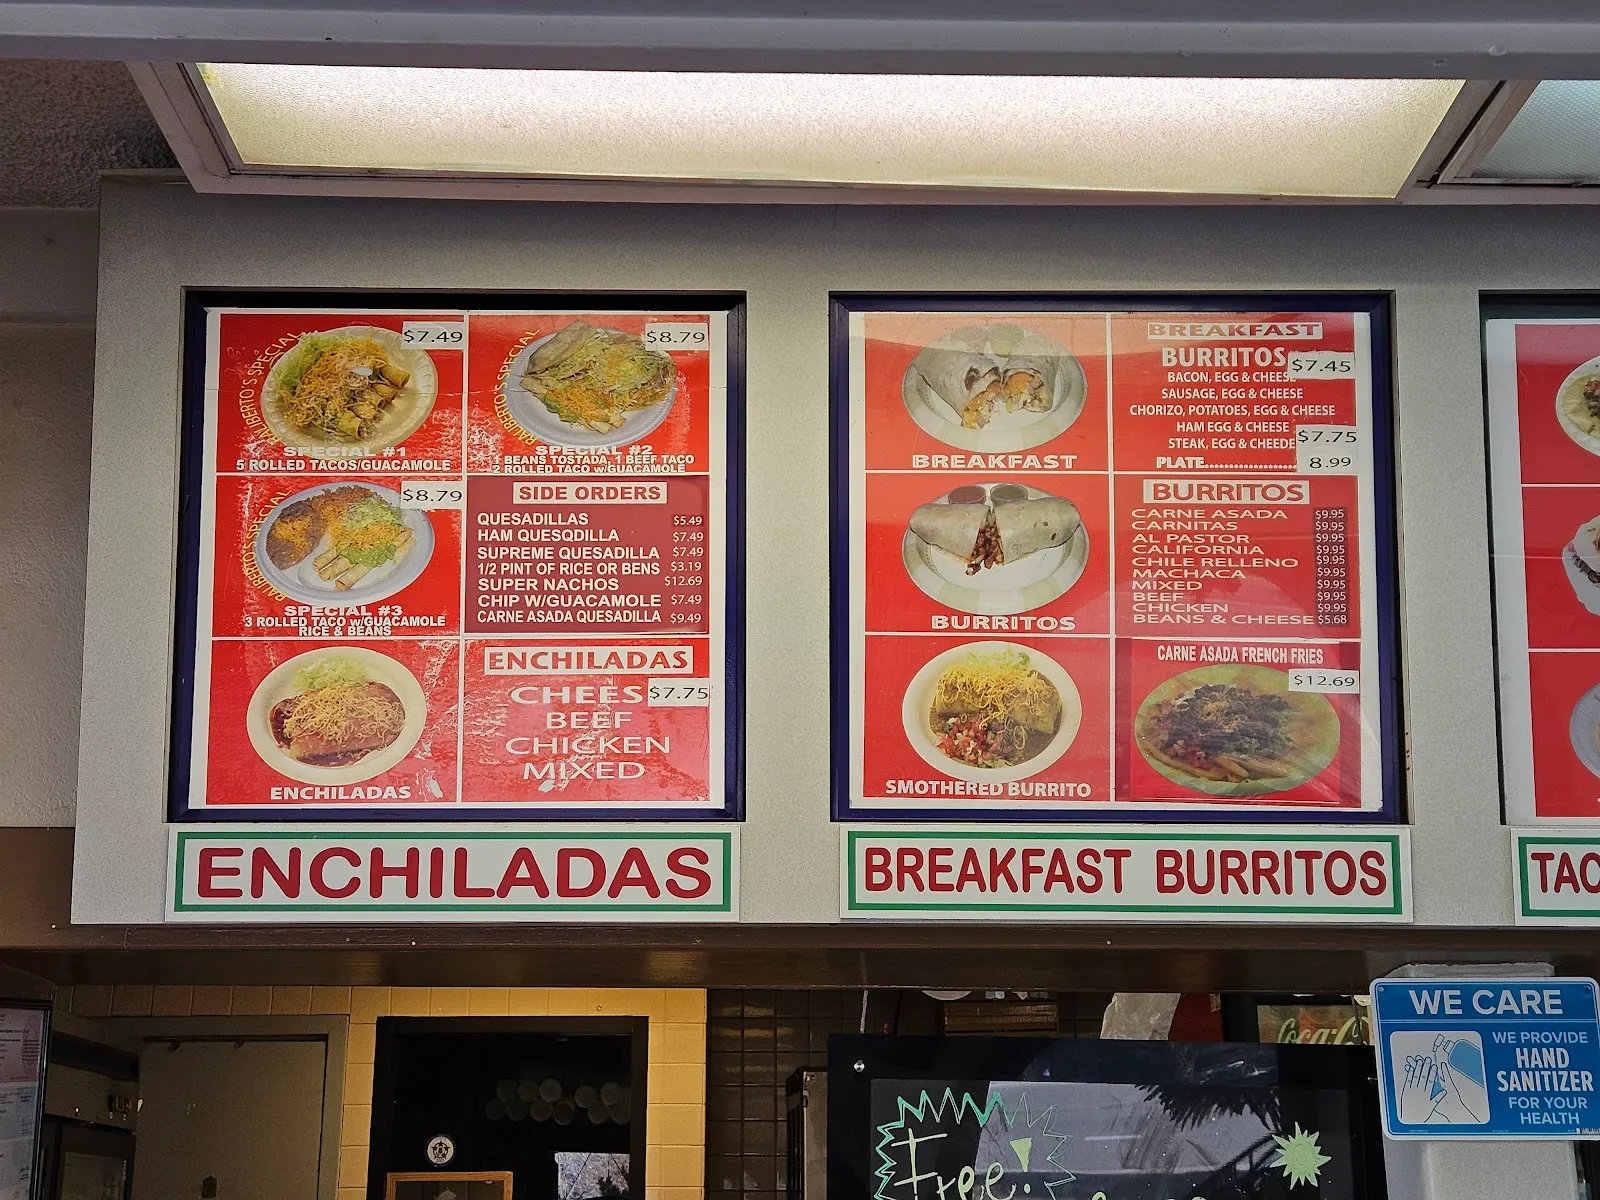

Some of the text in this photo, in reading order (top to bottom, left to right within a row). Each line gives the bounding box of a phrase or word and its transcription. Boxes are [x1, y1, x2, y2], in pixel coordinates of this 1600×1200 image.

[403, 329, 463, 343] $7.49
[1149, 324, 1320, 337] BREAKFAST
[647, 331, 705, 344] $8.79
[246, 331, 303, 377] SPECIAL
[497, 329, 540, 379] SPECIAL
[1162, 347, 1286, 367] BURRITOS
[1292, 359, 1351, 372] $7.45
[1167, 371, 1212, 384] BACON,
[1215, 372, 1239, 383] EGG
[1242, 372, 1250, 382] &
[1161, 388, 1303, 400] SAUSAGE, EGG & CHEESE
[1130, 405, 1335, 417] CHORIZO, POTATOES, EGG & CHEESE
[1177, 422, 1289, 433] HAM EGG & CHEESE
[1298, 429, 1357, 443] $7.75
[535, 445, 653, 455] SPECIAL #2
[1168, 438, 1208, 450] STEAK,
[1212, 438, 1236, 449] EGG
[1238, 438, 1247, 449] &
[283, 446, 406, 457] SPECIAL #1
[236, 459, 450, 471] 5 ROLLED TACOS/GUACAMOLE
[493, 455, 695, 465] 1 BEANS TOSTADA, 1 BEEF TACO
[912, 454, 1078, 469] BREAKFAST
[1310, 457, 1351, 469] 8.99
[493, 464, 686, 473] 2 ROLLED TACO w/GUACAMOLE
[403, 488, 462, 502] $8.79
[519, 486, 661, 500] SIDE ORDERS
[1153, 483, 1303, 501] BURRITOS
[246, 490, 292, 540] SPECIAL
[477, 513, 702, 526] QUESADILLAS $5.49
[1131, 509, 1345, 519] CARNE ASADA $9.95
[1132, 521, 1345, 531] CARNITAS $9.95
[478, 530, 704, 543] HAM QUESQDILLA $7.49
[1132, 533, 1345, 544] AL PASTOR $9.95
[477, 547, 704, 560] SUPREME QUESADILLA $7.49
[1132, 545, 1345, 555] CALIFORNIA $9.95
[478, 561, 702, 575] 1/2 PINT OF RICE OR BENS $3.19
[1132, 555, 1345, 568] CHILE RELLENO $9.95
[1132, 567, 1346, 579] MACHACA $9.95
[478, 576, 702, 591] SUPER NACHOS $12.69
[1132, 579, 1346, 590] MIXED $9.95
[478, 595, 702, 607] CHIP W/GUACAMOLE $7.49
[1133, 591, 1346, 602] BEEF $9.95
[284, 606, 403, 617] SPECIAL #3
[1133, 603, 1347, 613] CHICKEN $9.95
[245, 616, 445, 627] 3 ROLLED TACO w/GUACAMOLE
[477, 610, 702, 624] CARNE ASADA QUESADILLA $9.49
[931, 616, 1076, 630] BURRITOS
[1133, 614, 1347, 624] BEANS & CHEESE $5.68
[298, 625, 392, 636] RICE & BEANS
[489, 651, 688, 670] ENCHILADAS
[1157, 645, 1324, 664] CARNE ASADA FRENCH FRIES
[1294, 674, 1355, 687] $12.69
[510, 686, 643, 704] CHEES
[649, 686, 709, 700] $7.75
[546, 712, 633, 729] BEEF
[505, 737, 670, 754] CHICKEN
[523, 762, 646, 780] MIXED
[270, 786, 411, 800] ENCHILADAS
[886, 780, 1092, 797] SMOTHERED BURRITO
[198, 847, 711, 899] ENCHILADAS
[864, 847, 1387, 896] BREAKFAST BURRITOS
[1530, 852, 1600, 894] TAC
[1409, 990, 1563, 1015] WE CARE
[1492, 1032, 1588, 1044] WE PROVIDE
[1516, 1048, 1569, 1068] HAND
[1497, 1071, 1594, 1092] SANITIZER
[1509, 1097, 1588, 1109] FOR YOUR
[1520, 1113, 1579, 1125] HEALTH
[891, 1128, 1033, 1200] Free!
